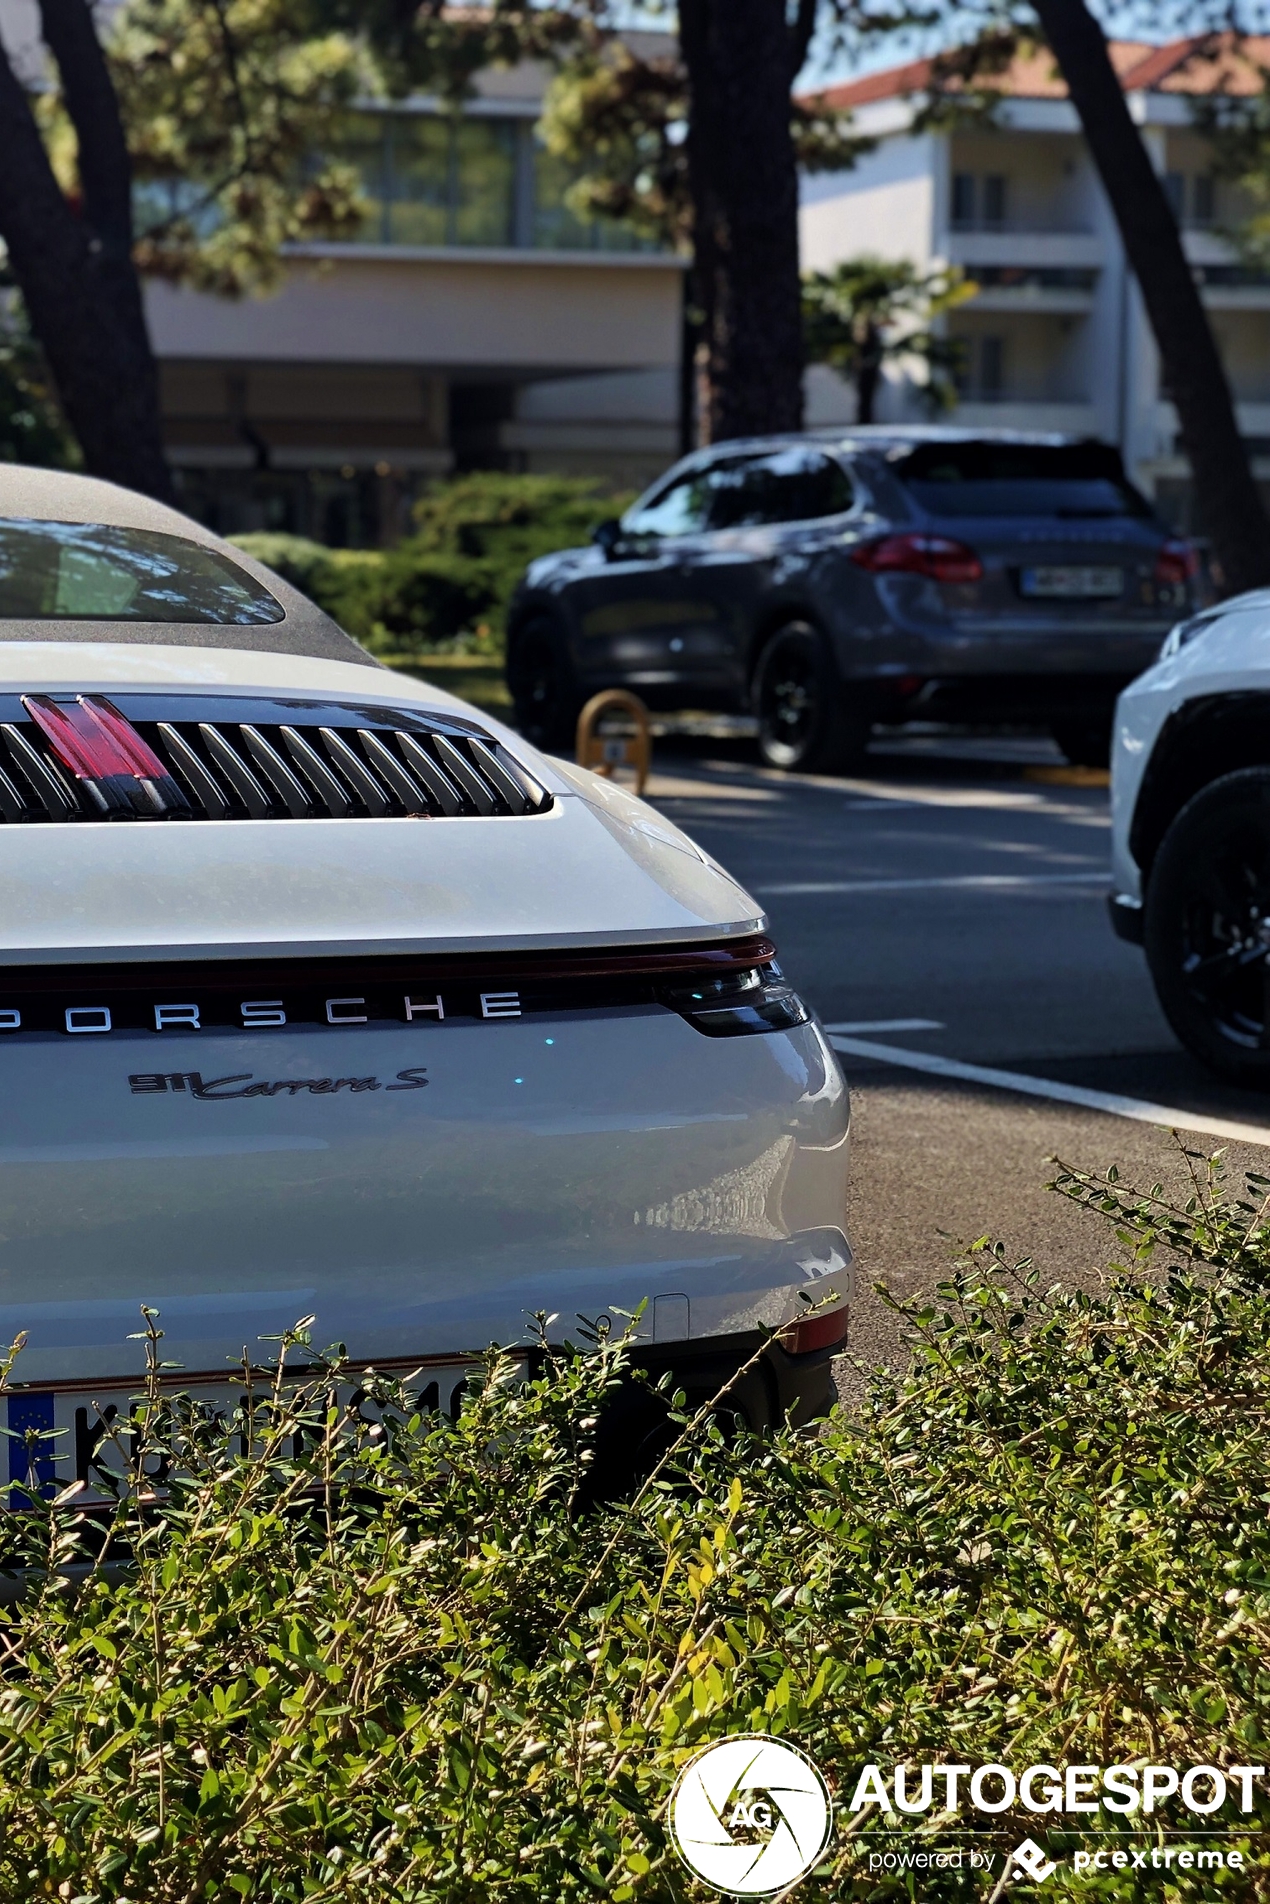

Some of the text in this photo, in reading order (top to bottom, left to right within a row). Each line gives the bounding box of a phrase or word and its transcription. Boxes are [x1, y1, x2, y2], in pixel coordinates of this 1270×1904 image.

[128, 1067, 429, 1100] 911 Carrera S
